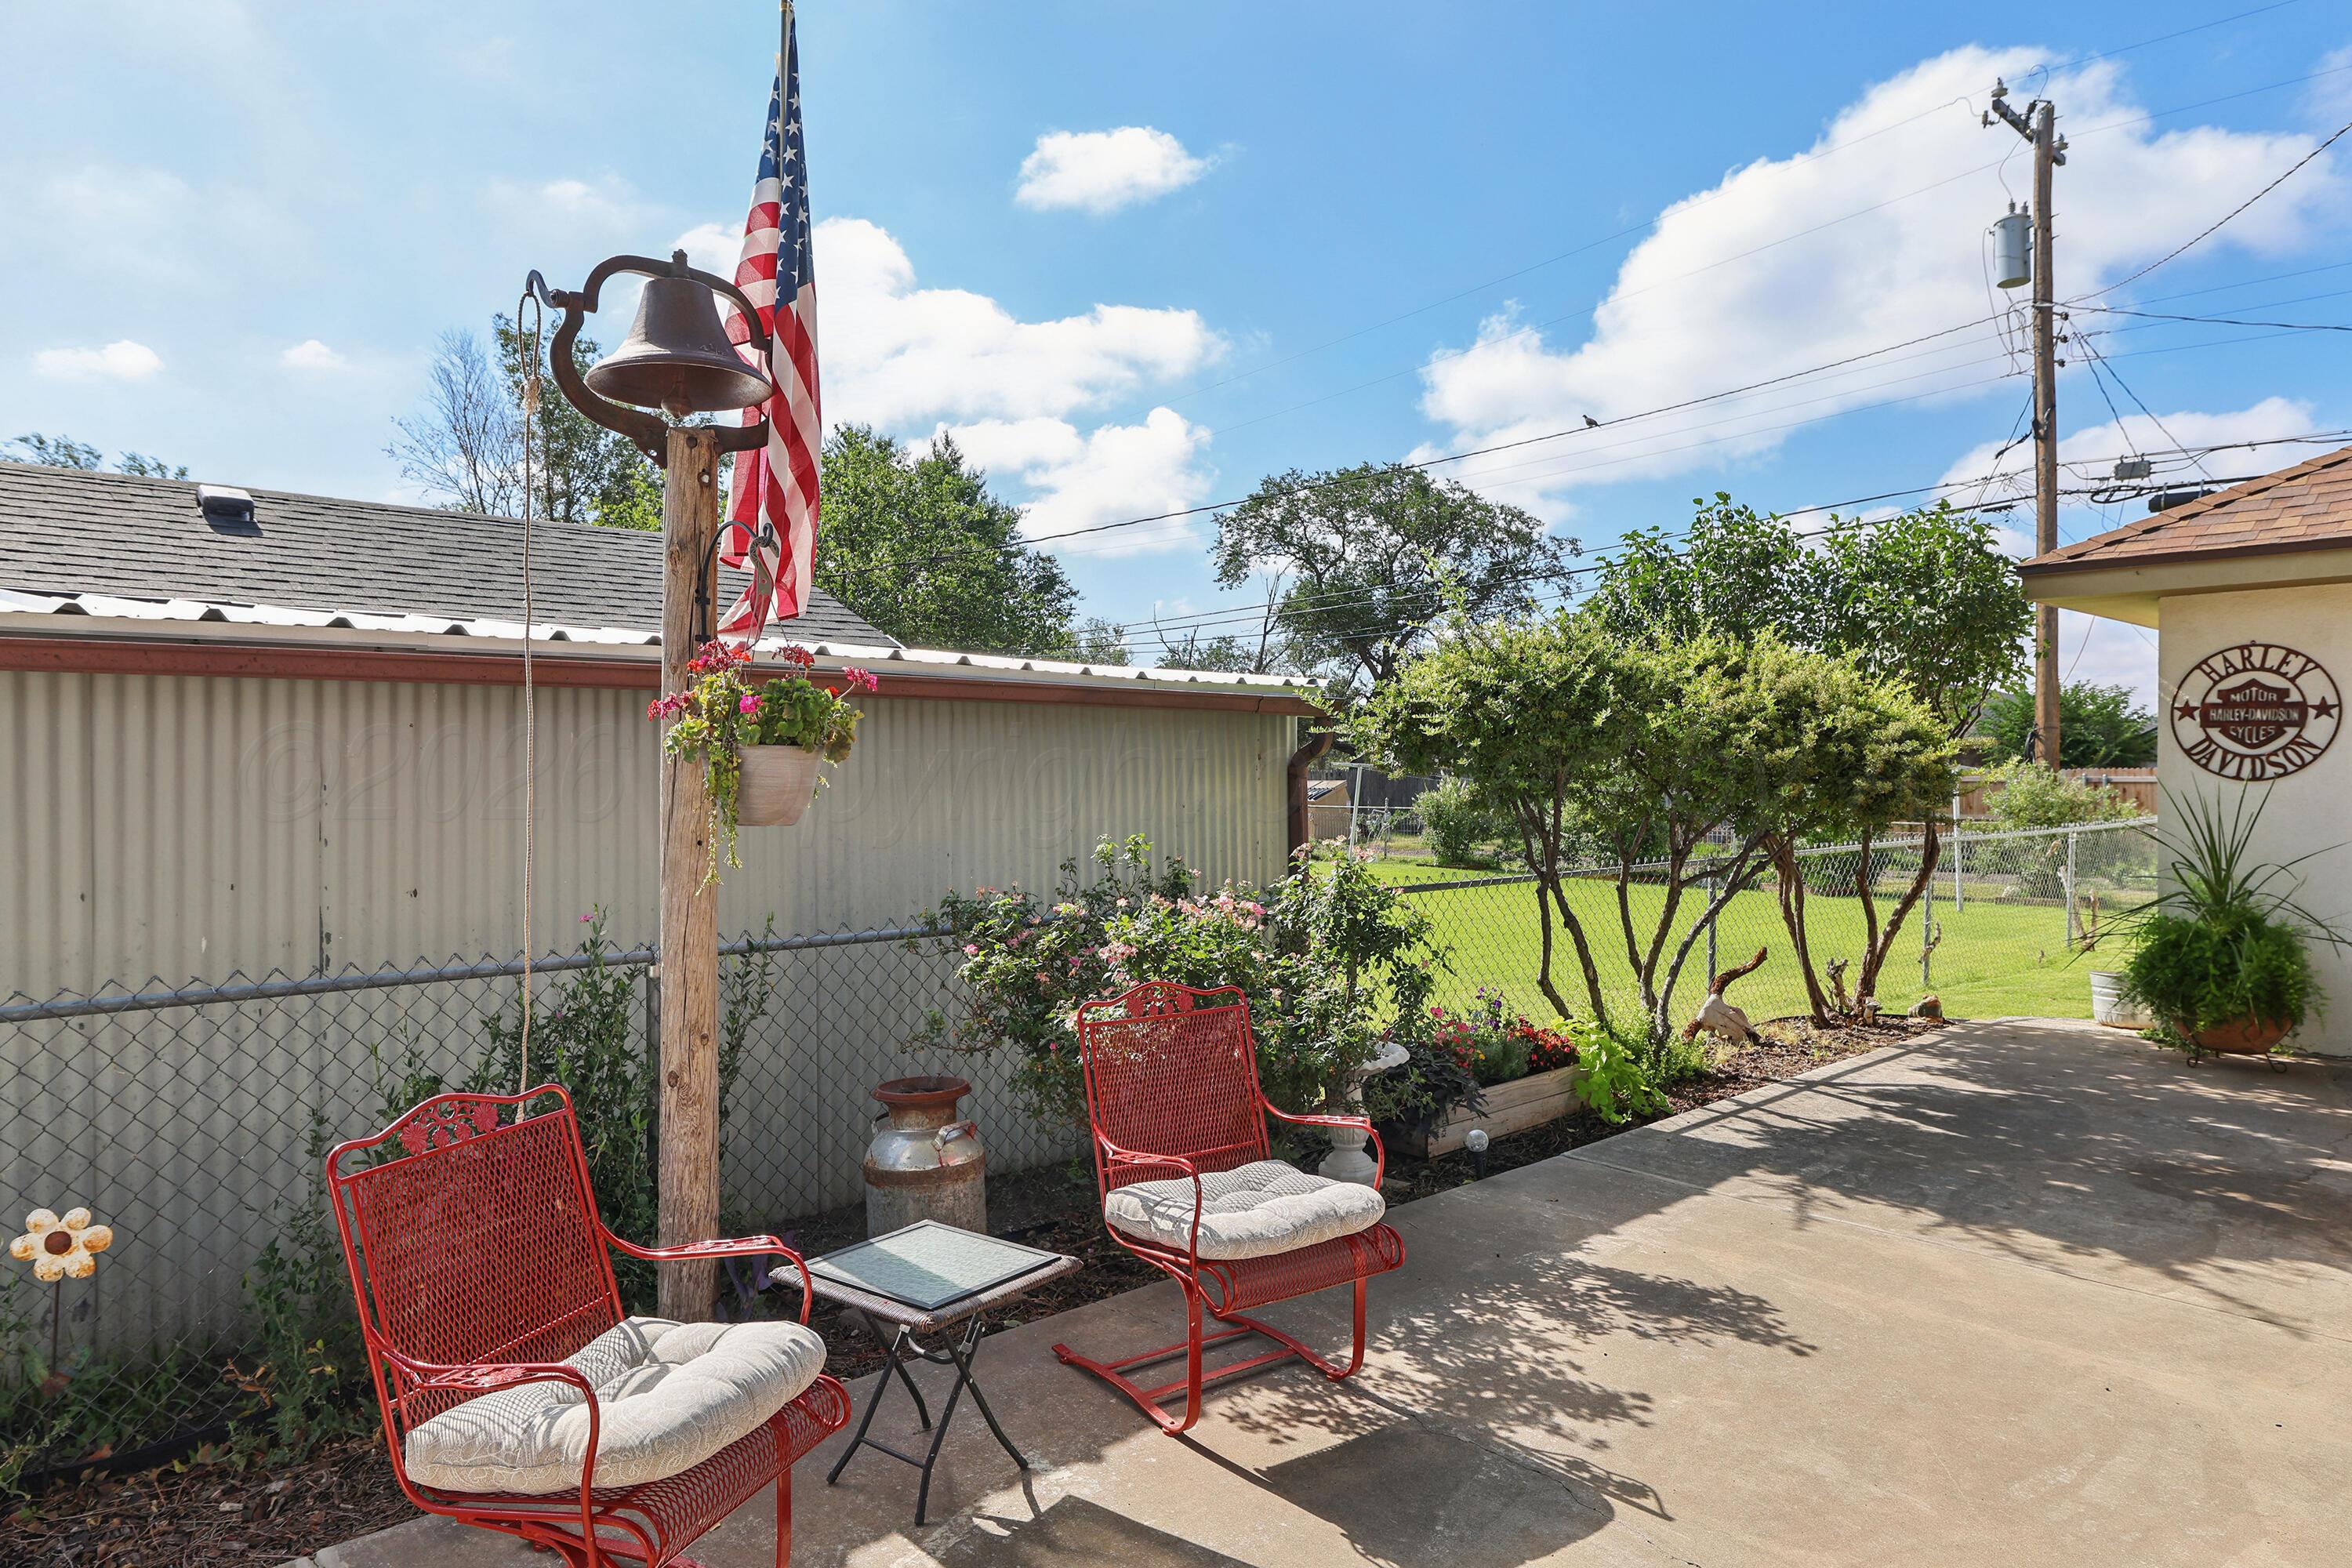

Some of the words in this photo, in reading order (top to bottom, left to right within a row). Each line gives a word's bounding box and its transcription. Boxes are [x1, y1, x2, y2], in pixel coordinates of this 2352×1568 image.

[2195, 644, 2320, 684] HARLEY
[2230, 687, 2278, 702] MOTOR
[2209, 708, 2299, 721] HARLEY-DAVIDSON
[2230, 726, 2276, 743] CYCLES
[2184, 735, 2325, 781] DAVIDSON
